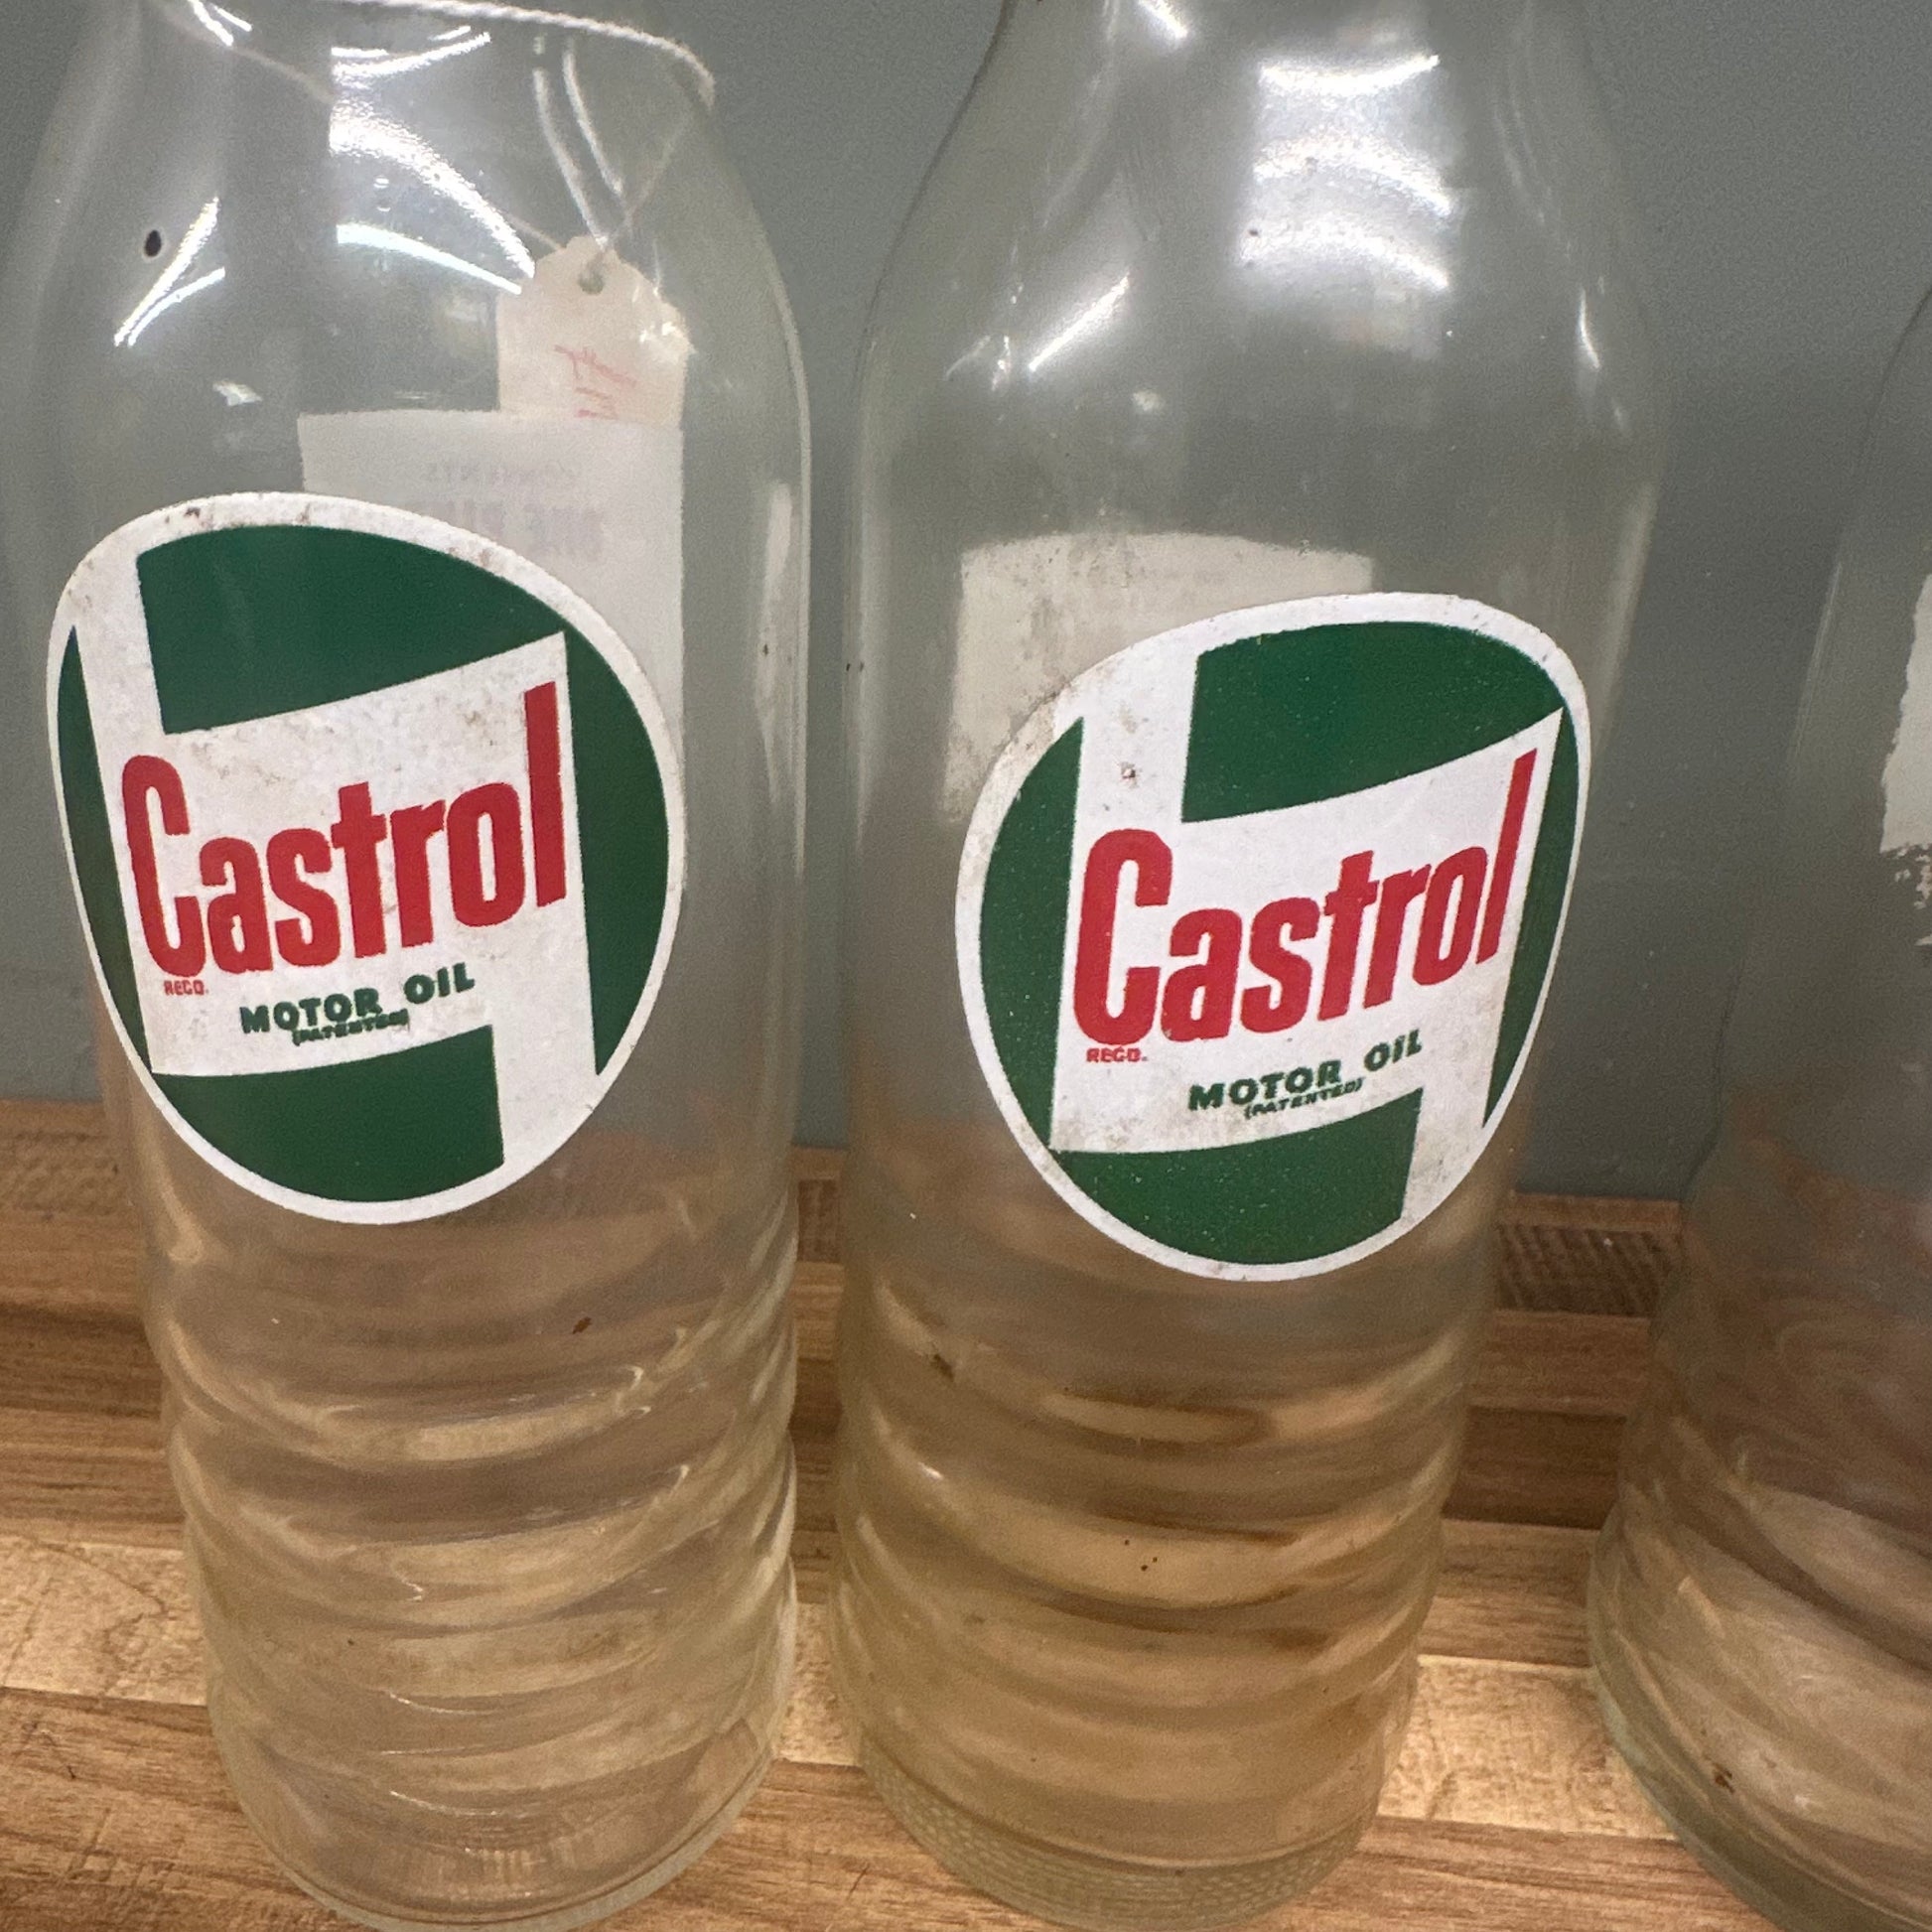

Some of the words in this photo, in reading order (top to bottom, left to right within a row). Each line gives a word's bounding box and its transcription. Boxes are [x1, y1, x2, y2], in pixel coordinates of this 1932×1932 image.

[121, 681, 568, 977] Castrol
[1072, 749, 1538, 1045] Castrol
[239, 988, 383, 1034] MOTOR
[403, 962, 476, 1004] OIL
[1187, 1059, 1342, 1111] MOTOR
[1363, 1029, 1423, 1071] OIL
